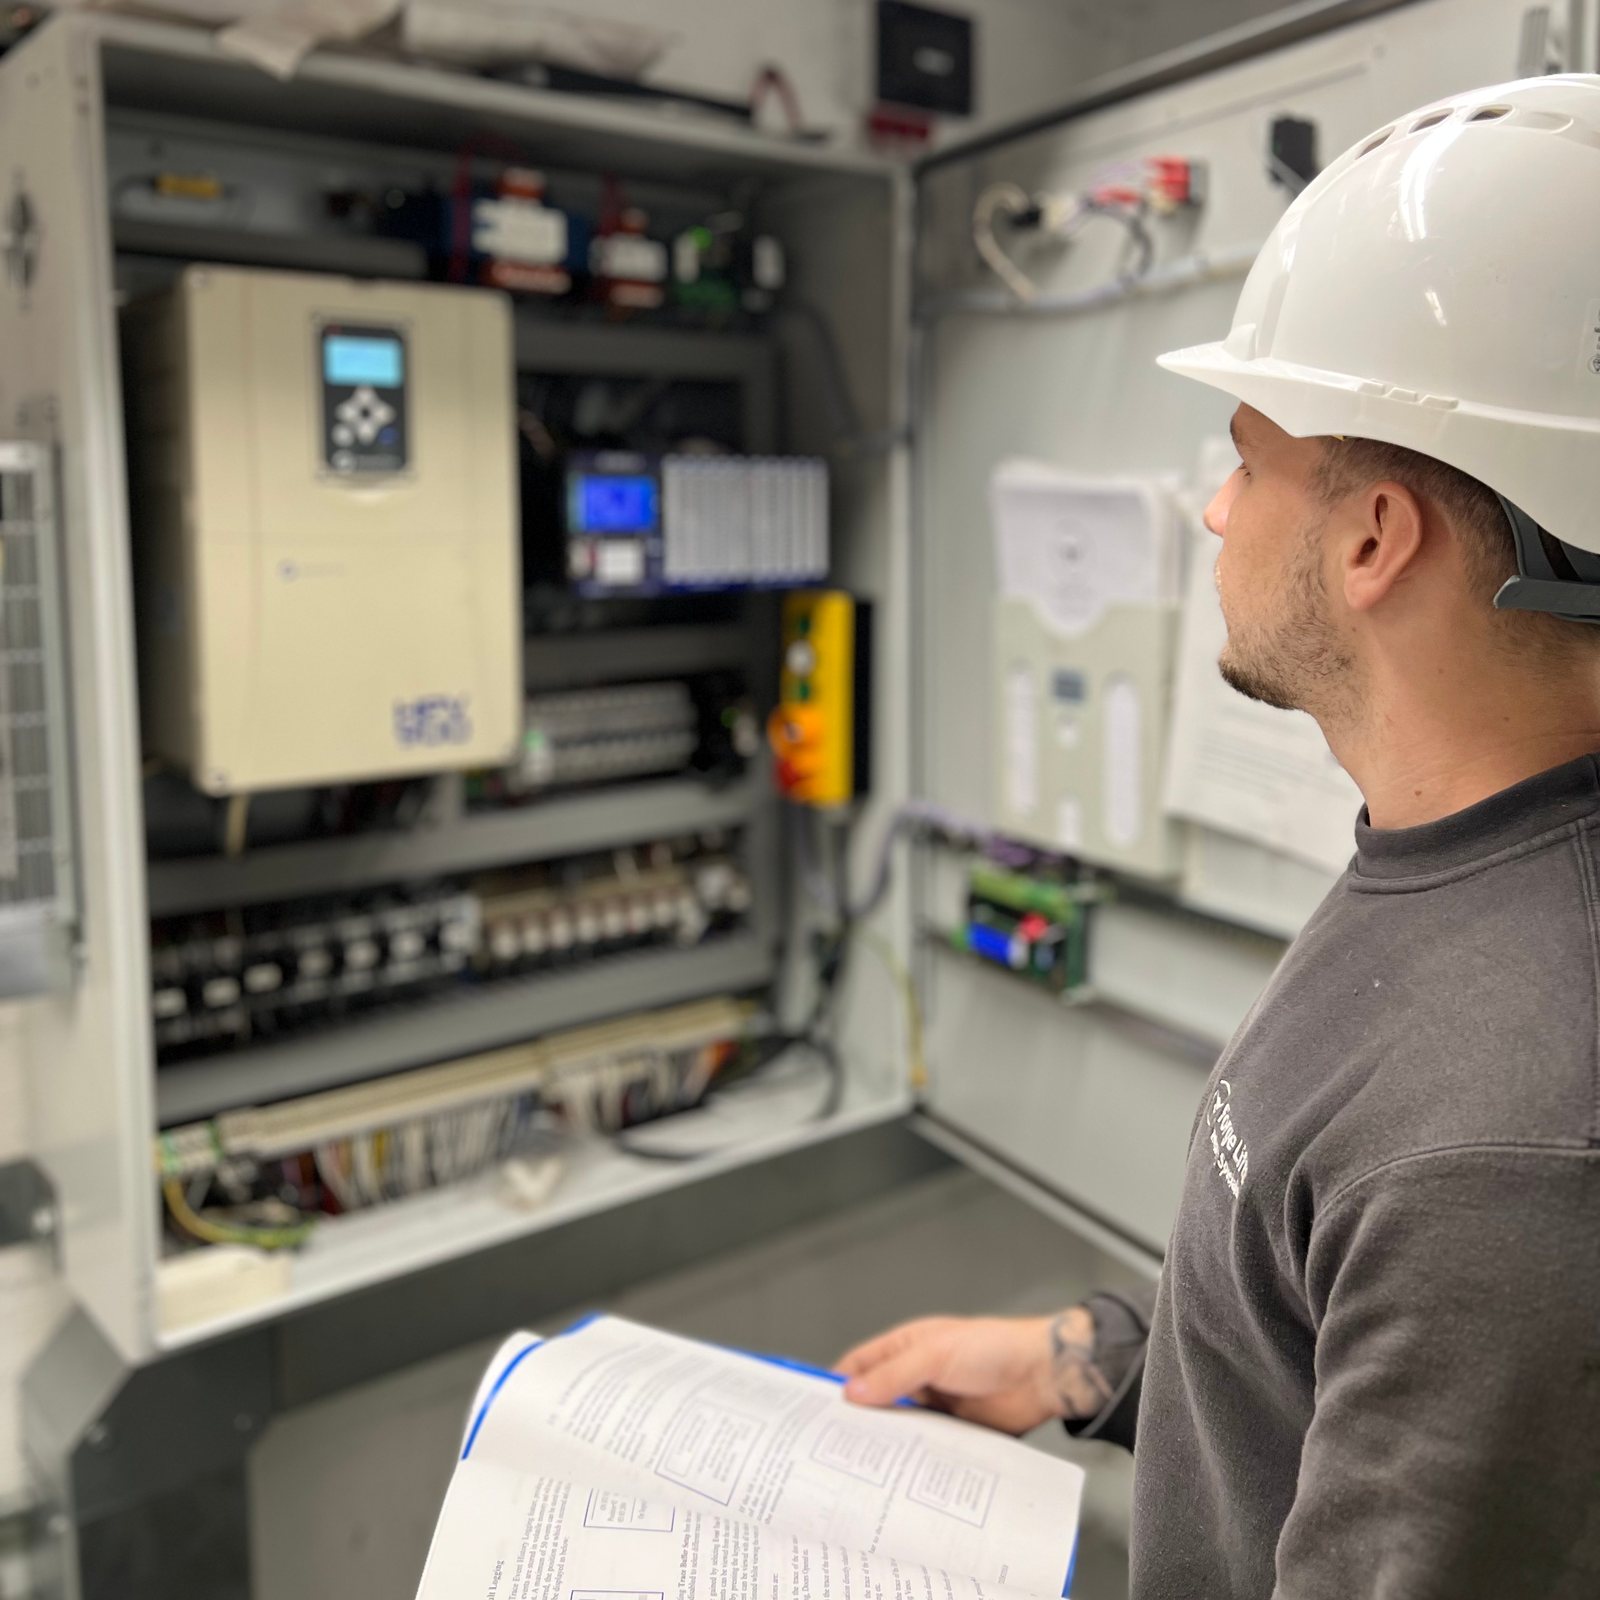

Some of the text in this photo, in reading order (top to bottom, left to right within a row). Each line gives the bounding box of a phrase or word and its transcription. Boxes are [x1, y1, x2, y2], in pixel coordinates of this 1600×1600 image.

[516, 1542, 529, 1563] History
[680, 1549, 688, 1568] Buffer
[488, 1560, 504, 1590] Logging
[512, 1564, 523, 1582] Event
[553, 1563, 564, 1591] displayed
[678, 1569, 686, 1587] Trace
